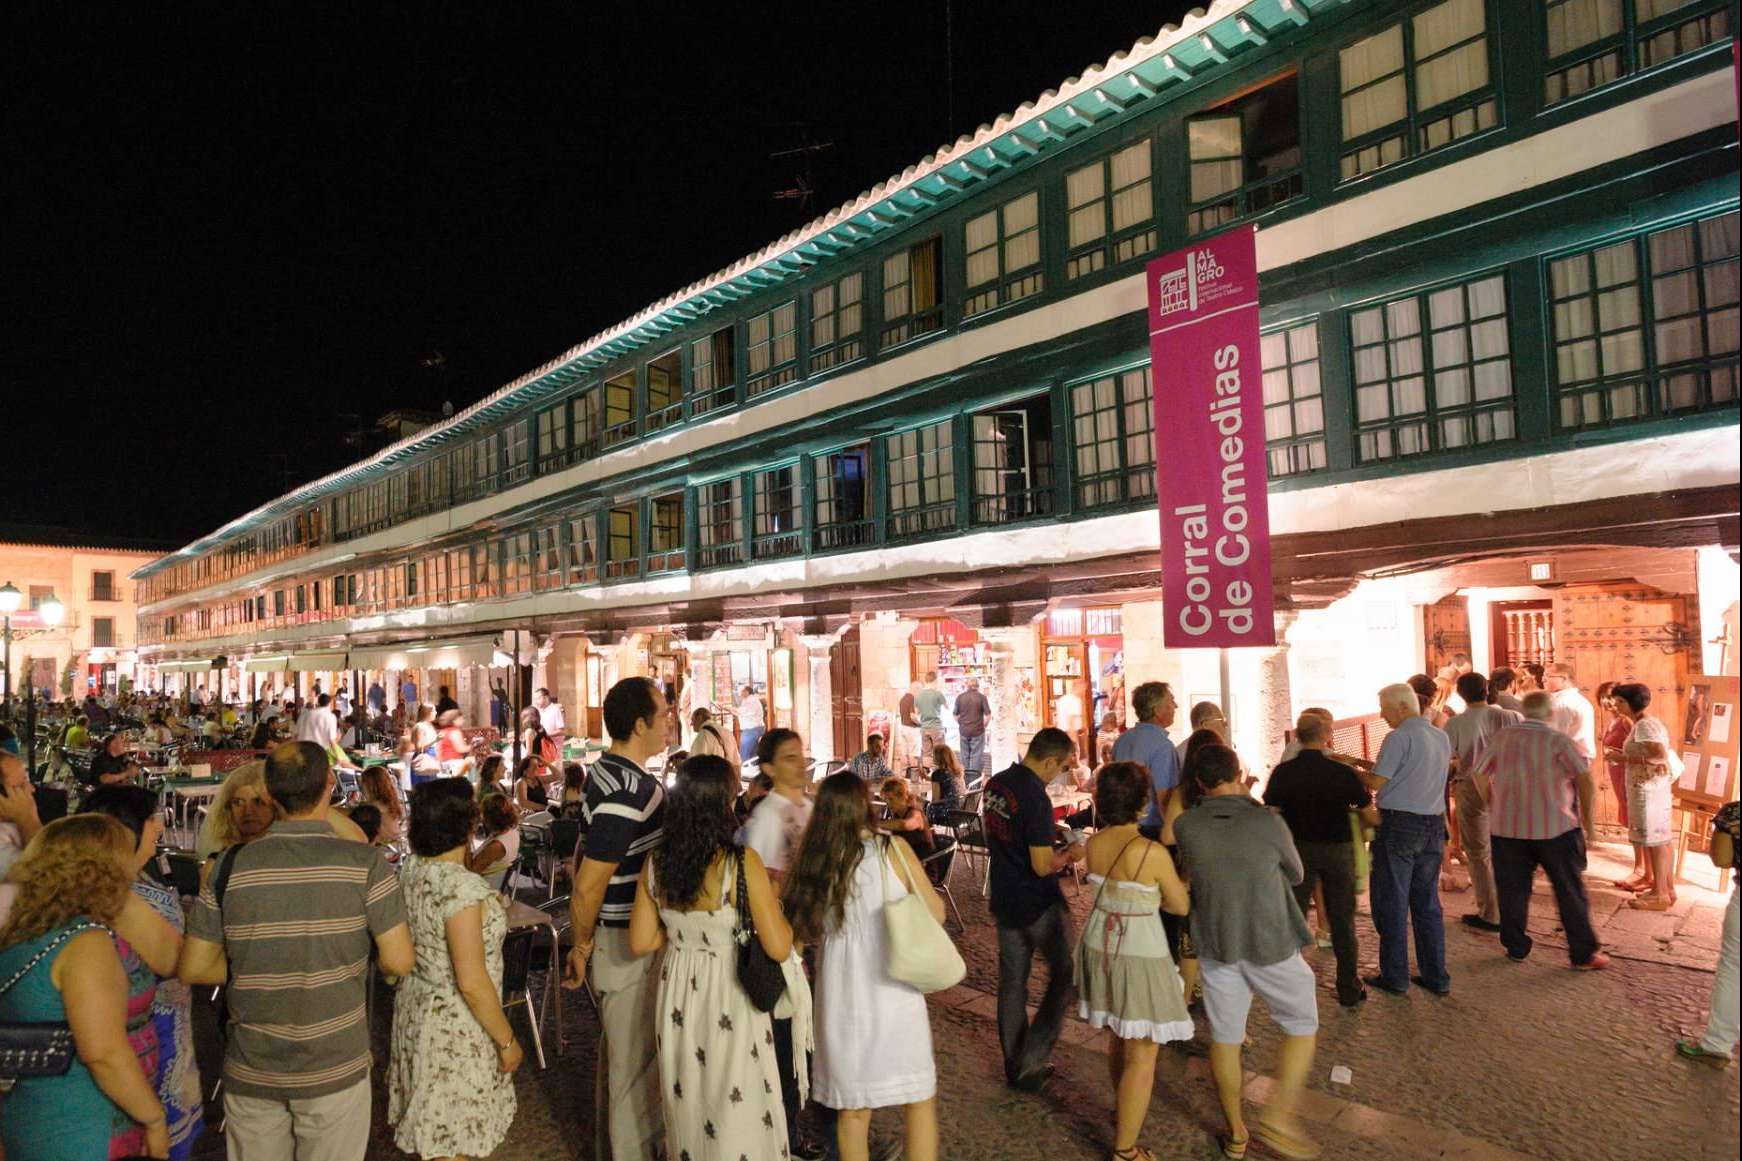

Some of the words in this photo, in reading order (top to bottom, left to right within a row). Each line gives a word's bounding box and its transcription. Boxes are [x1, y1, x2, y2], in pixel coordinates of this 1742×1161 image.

[1197, 248, 1216, 261] AL
[1197, 258, 1217, 274] MA
[1197, 265, 1225, 284] GRO
[1210, 343, 1251, 567] Comedias
[1175, 503, 1213, 636] Corral
[1218, 580, 1254, 635] de
